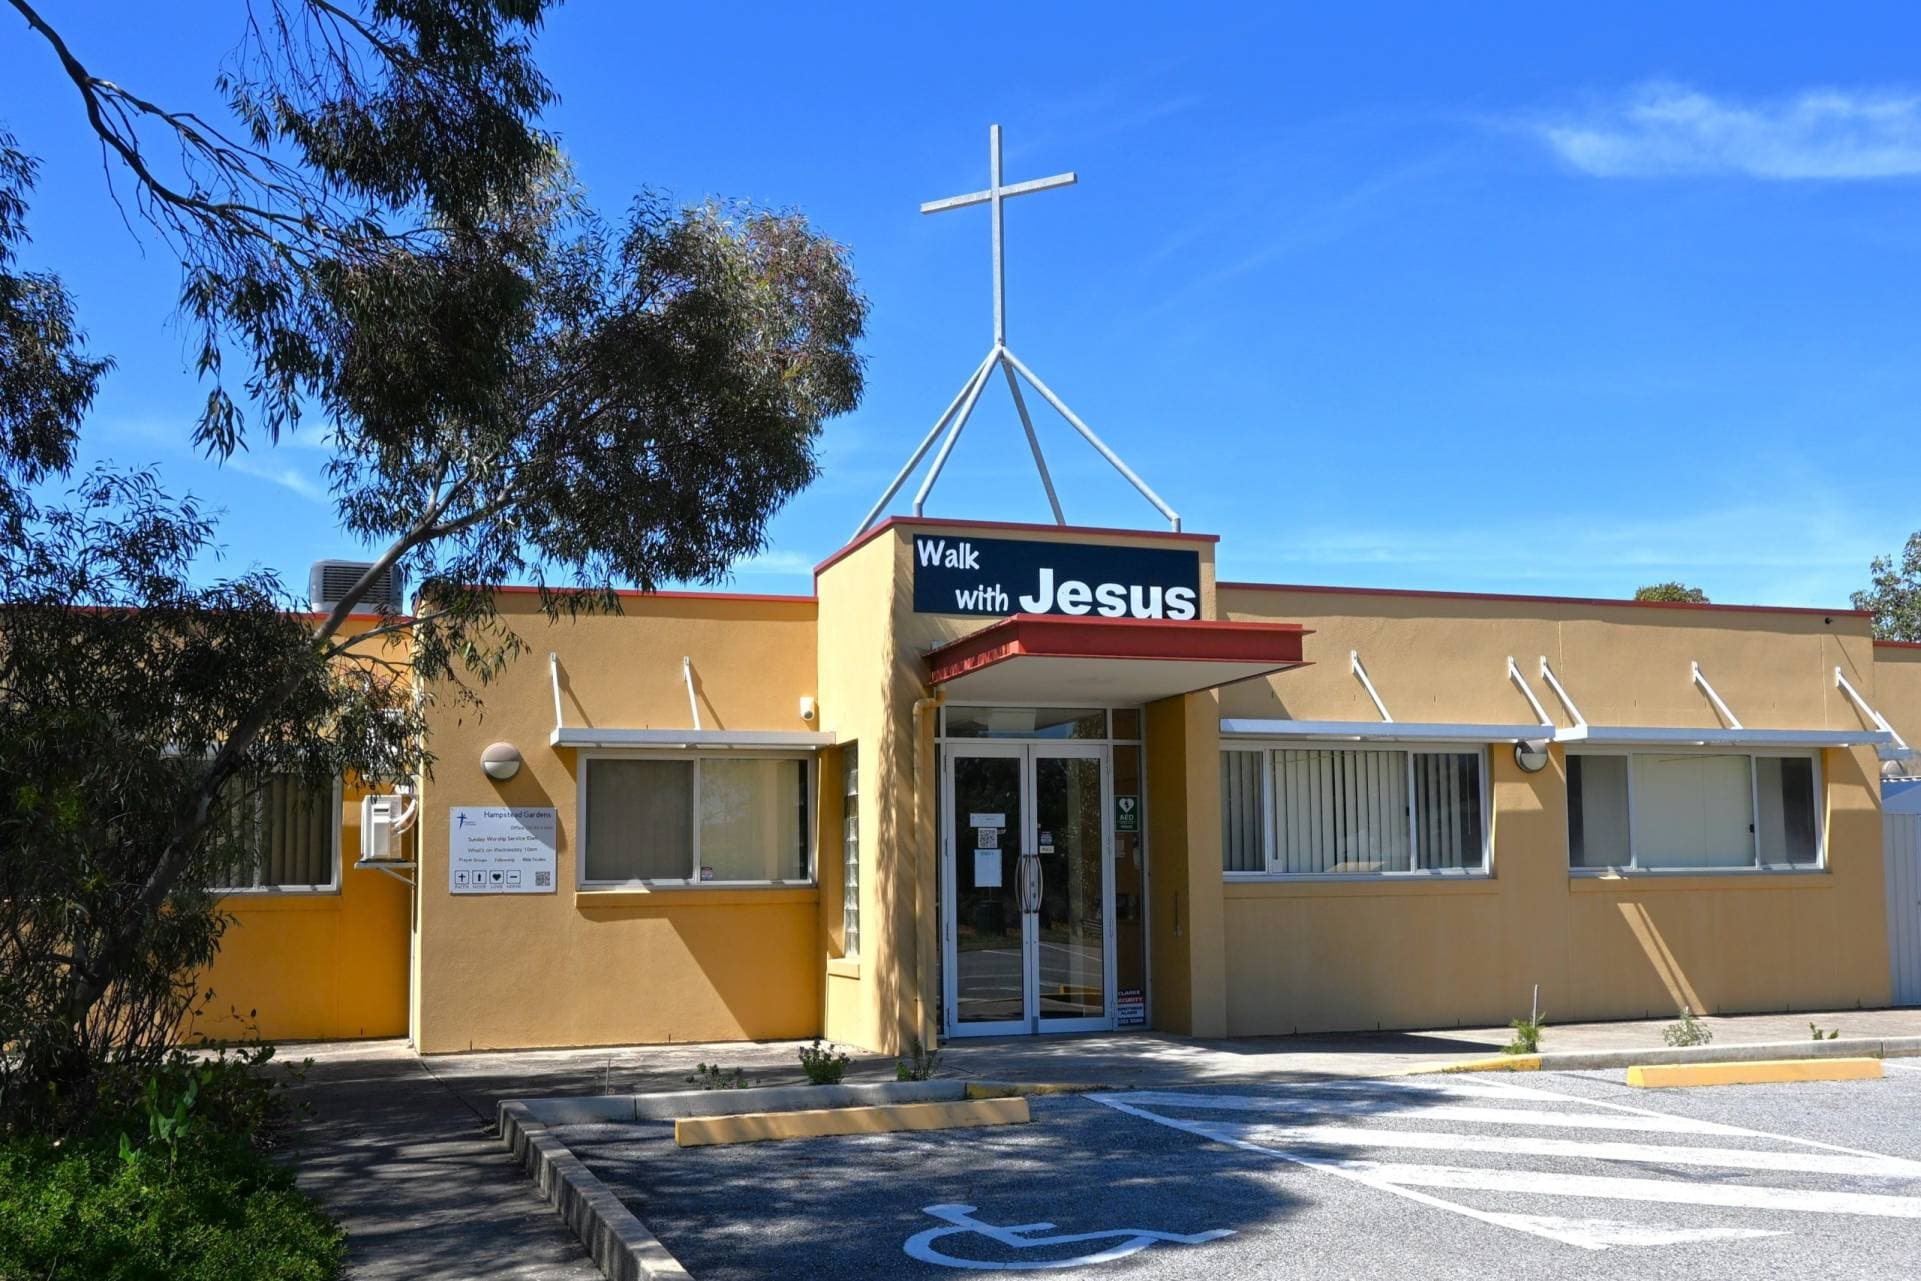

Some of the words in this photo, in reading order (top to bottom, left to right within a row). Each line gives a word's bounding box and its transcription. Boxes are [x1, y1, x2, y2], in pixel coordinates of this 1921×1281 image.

[917, 539, 980, 570] Walk
[955, 584, 1009, 612] with
[1019, 568, 1196, 621] Jesus
[484, 811, 522, 819] Hampstead
